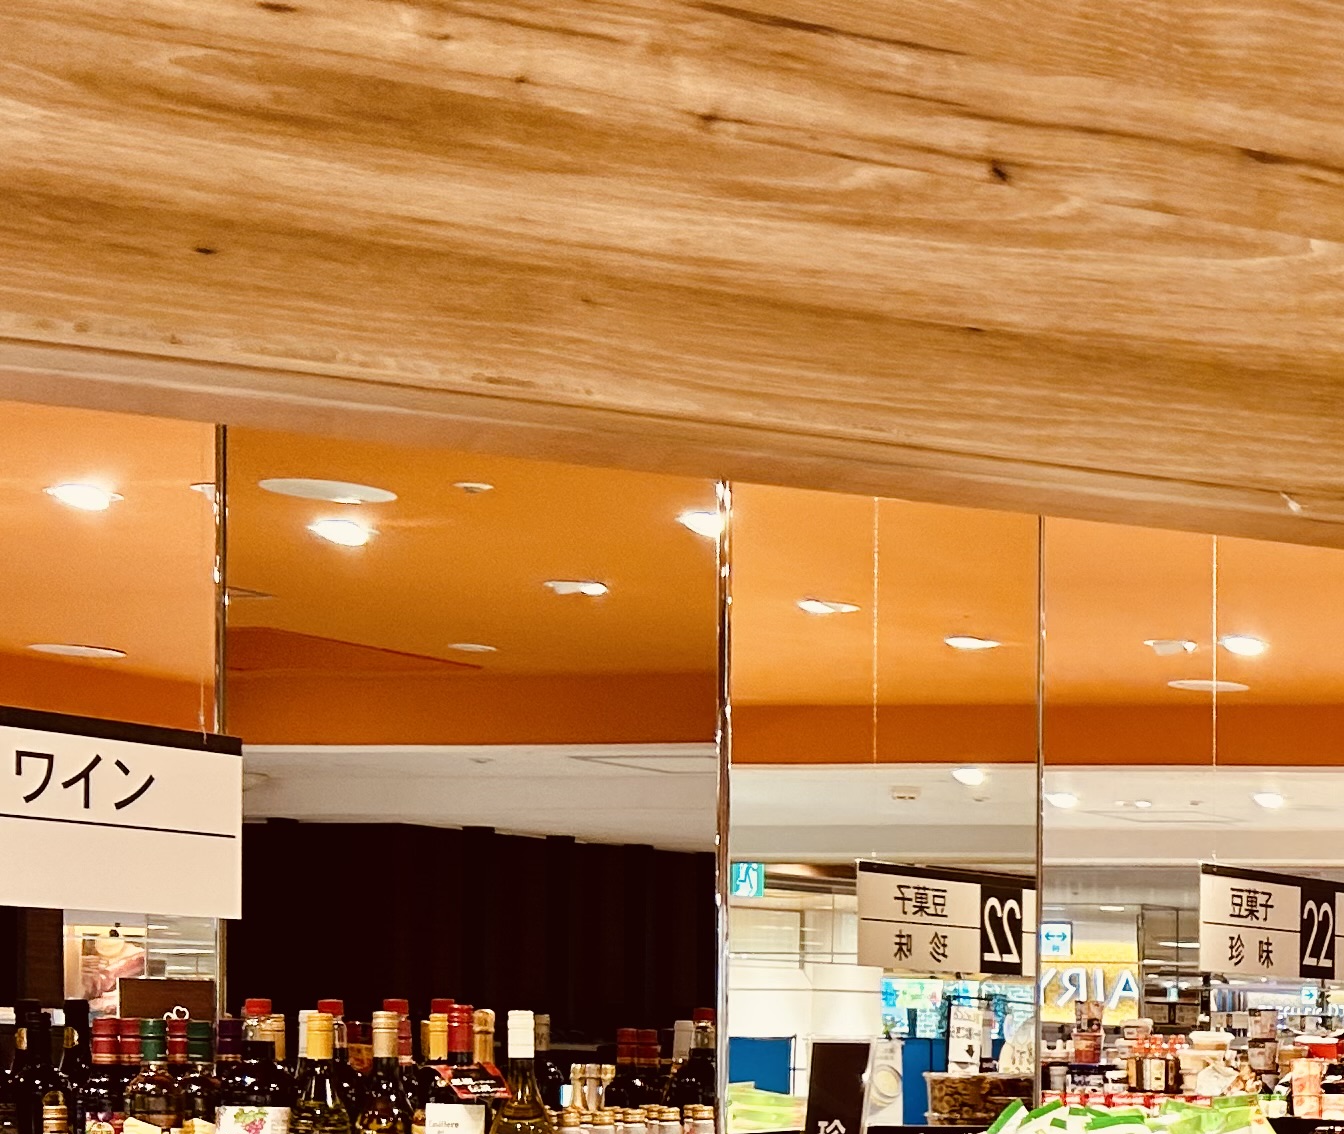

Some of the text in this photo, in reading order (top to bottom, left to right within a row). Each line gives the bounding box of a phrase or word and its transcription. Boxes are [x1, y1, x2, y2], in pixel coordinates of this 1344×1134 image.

[13, 749, 156, 810] ワイン
[1229, 888, 1274, 922] 豆菓子
[1302, 900, 1334, 968] 22
